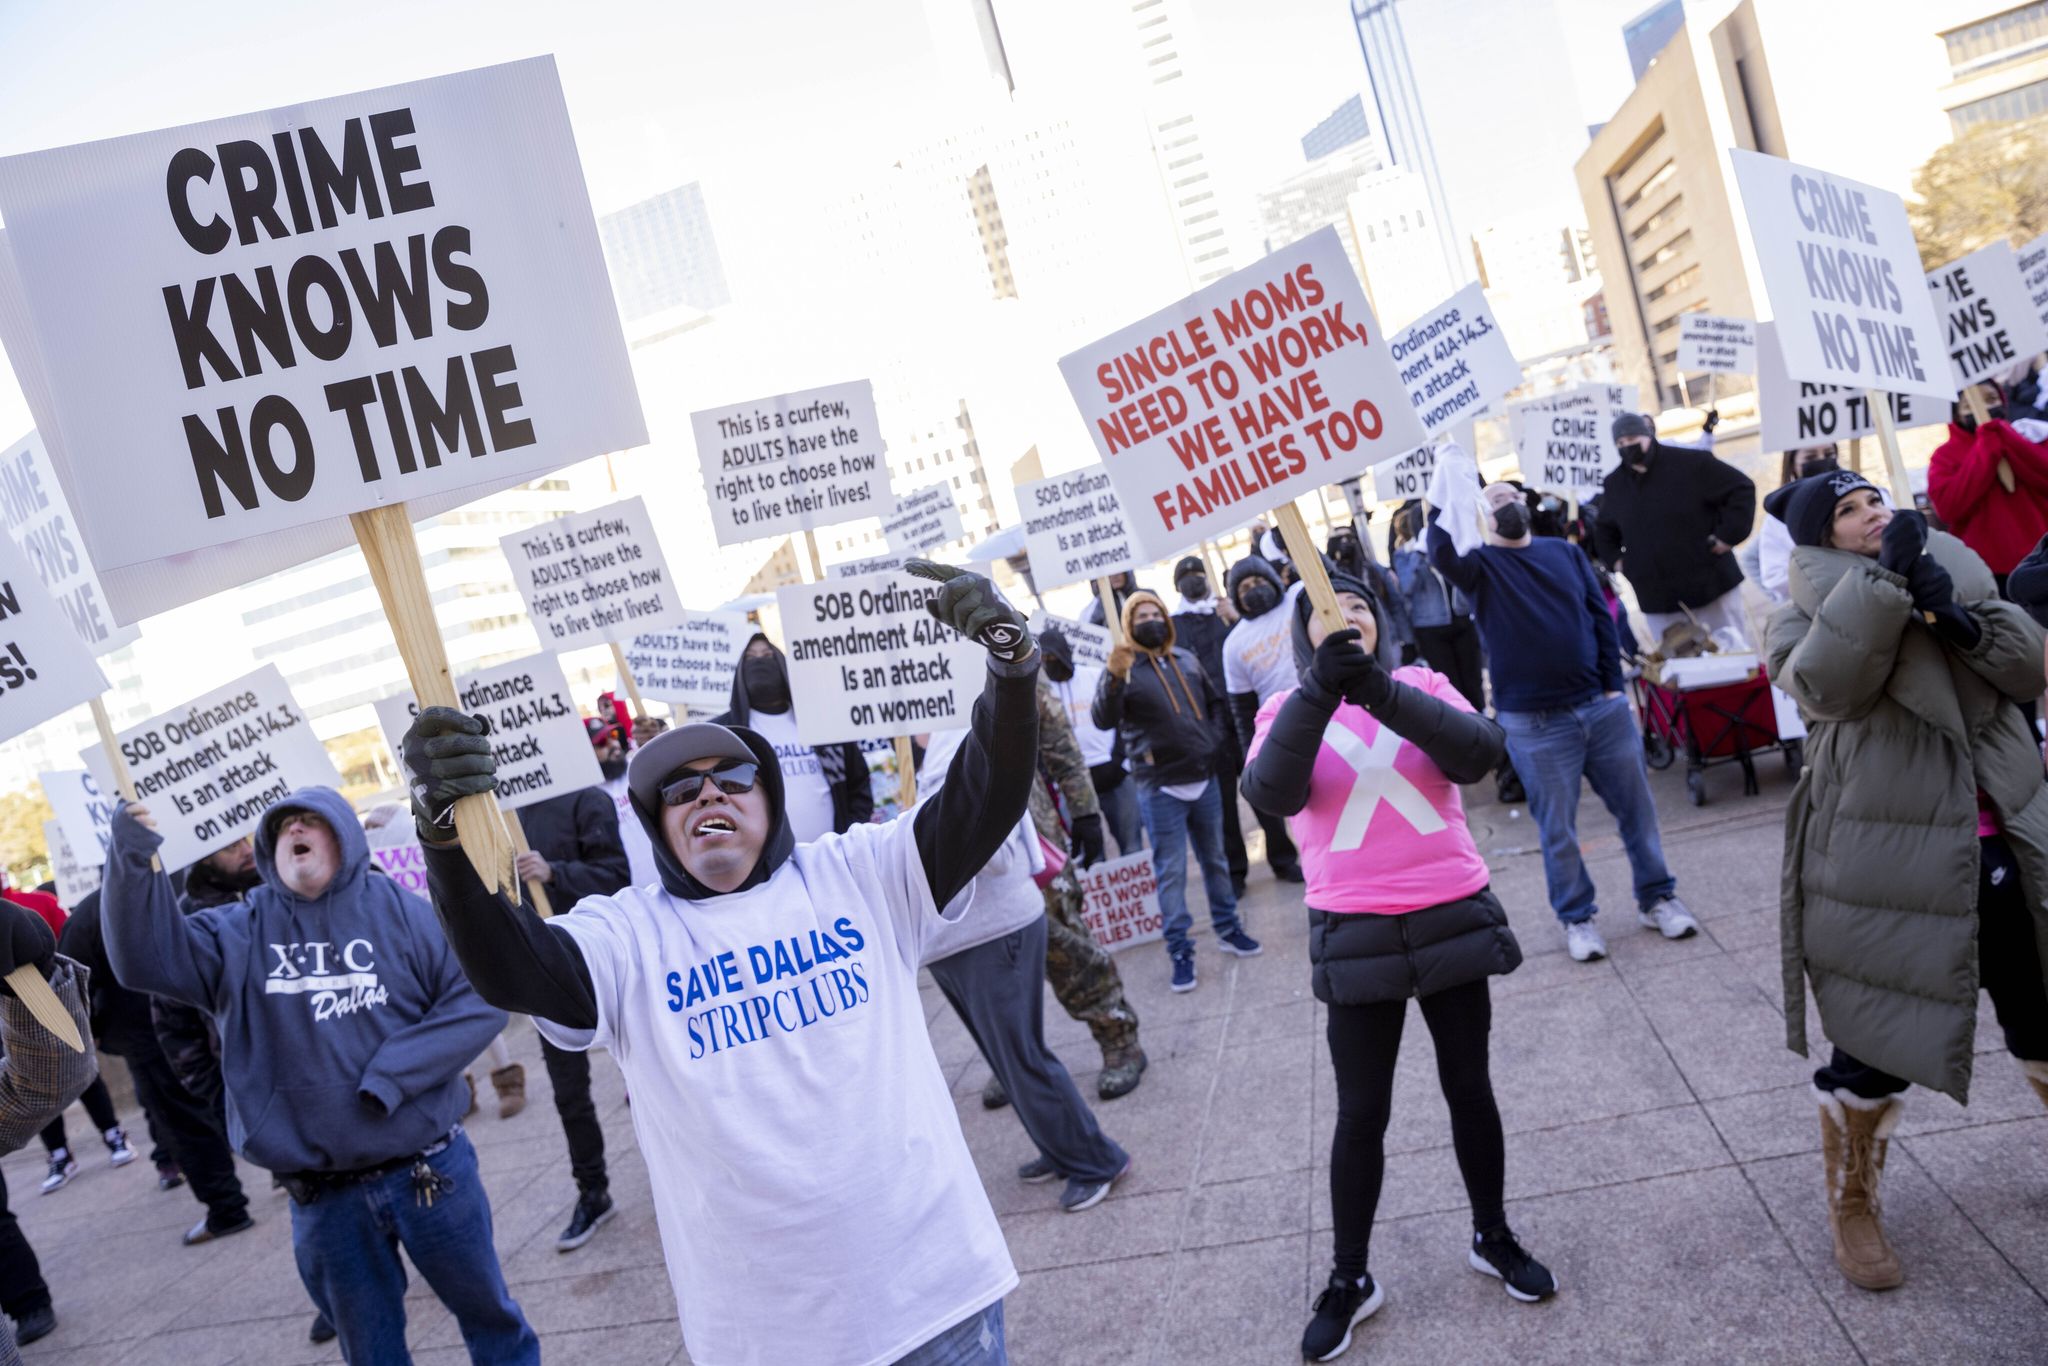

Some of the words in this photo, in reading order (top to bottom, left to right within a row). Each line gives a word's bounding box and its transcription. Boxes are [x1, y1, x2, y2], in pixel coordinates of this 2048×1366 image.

[167, 108, 435, 255] CRIME
[1791, 174, 1878, 246] CRIME
[1797, 240, 1903, 315] KNOWS
[162, 226, 490, 390] KNOWS
[1097, 317, 1217, 403] SINGLE
[1213, 263, 1325, 346] MOMS
[1391, 308, 1461, 361] Ordinance
[1812, 310, 1861, 374] NO
[1857, 317, 1926, 383] TIME
[1951, 329, 2016, 378] TIME
[1097, 384, 1188, 455] NEED
[1187, 360, 1240, 410] TO
[1238, 301, 1369, 386] WORK,
[1425, 358, 1471, 400] attack
[718, 414, 752, 439] This
[756, 411, 770, 431] is
[775, 413, 784, 429] a
[788, 400, 850, 426] curfew,
[1167, 415, 1233, 472] WE
[1229, 369, 1330, 446] HAVE
[1422, 380, 1480, 429] women!
[1798, 402, 1837, 439] NO
[1845, 393, 1912, 431] TIE
[181, 395, 315, 519] NO
[323, 344, 537, 484] TIME
[722, 439, 785, 469] ADULTS
[787, 435, 827, 456] have
[830, 425, 859, 447] the
[1552, 418, 1597, 440] CRIME
[1153, 433, 1306, 532] FAMILIES
[1303, 399, 1383, 461] TOO
[1546, 441, 1602, 463] KNOWS
[715, 475, 755, 502] right
[757, 472, 775, 491] to
[779, 464, 837, 488] choose
[840, 454, 876, 476] how
[1035, 485, 1061, 507] SOB
[1063, 473, 1111, 498] Ordinan
[1395, 473, 1417, 495] NO
[1544, 464, 1566, 484] NO
[1570, 466, 1604, 487] TIME
[732, 507, 750, 525] to
[752, 500, 782, 522] live
[784, 490, 823, 516] their
[827, 482, 871, 507] lives!
[1026, 503, 1096, 535] amendment
[522, 538, 550, 561] This
[550, 533, 564, 553] is
[567, 533, 576, 548] a
[577, 518, 630, 545] curfew,
[1057, 534, 1069, 552] Is
[1071, 531, 1086, 547] an
[1087, 517, 1126, 543] attack
[531, 561, 582, 588] ADULTS
[582, 552, 615, 575] have
[617, 542, 642, 560] the
[1065, 558, 1081, 574] on
[1083, 542, 1130, 568] women!
[532, 594, 562, 617] right
[564, 589, 580, 607] to
[581, 579, 629, 602] choose
[630, 567, 661, 589] how
[814, 592, 855, 622] SOB
[859, 582, 944, 617] Ordinan
[550, 620, 566, 638] to
[566, 614, 590, 635] live
[591, 606, 623, 630] their
[625, 594, 663, 620] lives!
[633, 634, 679, 650] ADULTS
[682, 637, 709, 652] have
[713, 640, 731, 654] the
[656, 655, 668, 669] to
[671, 655, 711, 671] choose
[792, 626, 907, 660] amendment
[460, 672, 534, 711] rdinance
[647, 673, 668, 688] live
[671, 674, 698, 690] their
[841, 664, 859, 691] Is
[863, 667, 886, 689] an
[891, 652, 953, 687] attack
[120, 731, 167, 767] SOB
[164, 689, 259, 746] Ordinance
[850, 702, 874, 726] on
[880, 689, 956, 722] women!
[114, 739, 229, 801] mendment
[171, 793, 194, 816] Is
[192, 781, 221, 808] an
[221, 751, 279, 794] attack
[194, 816, 222, 842] on
[224, 777, 292, 828] women!
[1107, 861, 1152, 887] MOMS
[1091, 892, 1112, 909] TO
[1106, 900, 1145, 924] HAVE
[1134, 914, 1164, 934] TOO
[666, 951, 744, 1013] SAVE
[747, 917, 865, 985] DALLAS
[310, 984, 389, 1022] Dallas
[687, 962, 869, 1060] STRIPCLUBS
